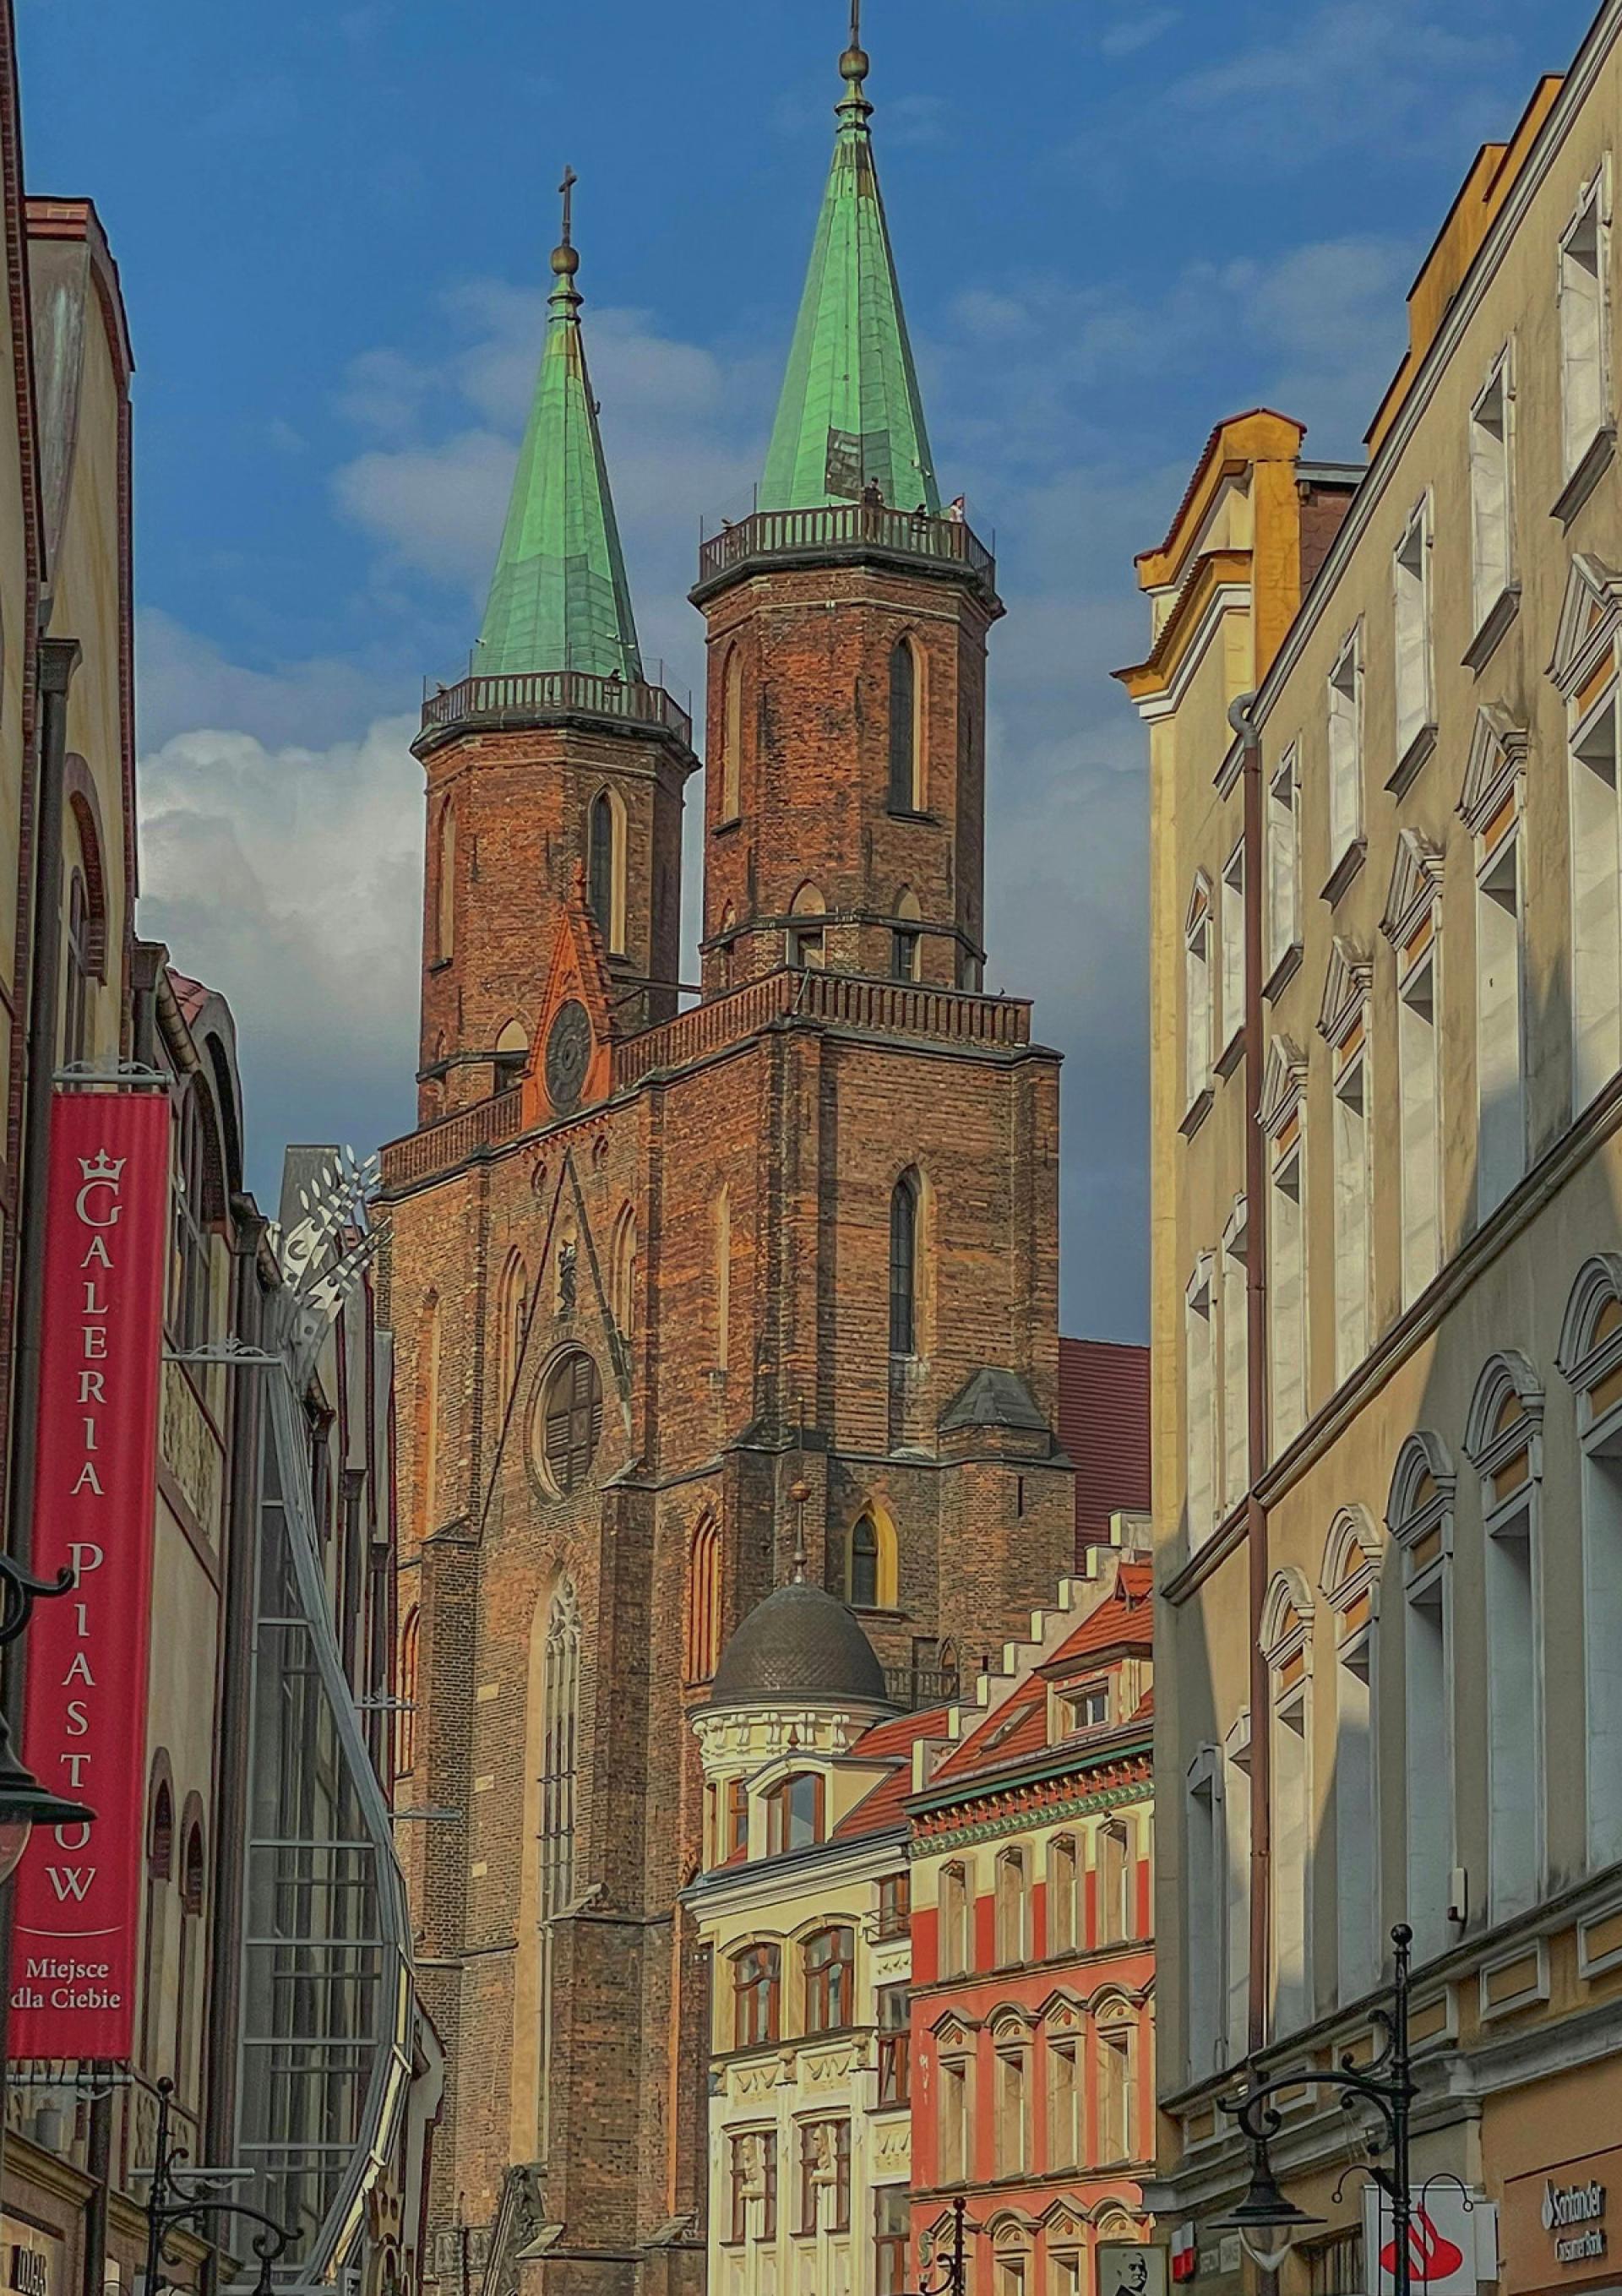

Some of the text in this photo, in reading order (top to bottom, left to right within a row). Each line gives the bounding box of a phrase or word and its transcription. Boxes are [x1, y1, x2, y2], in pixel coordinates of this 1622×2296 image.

[70, 1182, 122, 1494] GALERIA
[26, 1958, 109, 1984] Miejsce
[10, 1988, 121, 2009] dla Ciebie
[1554, 2179, 1601, 2226] Santander
